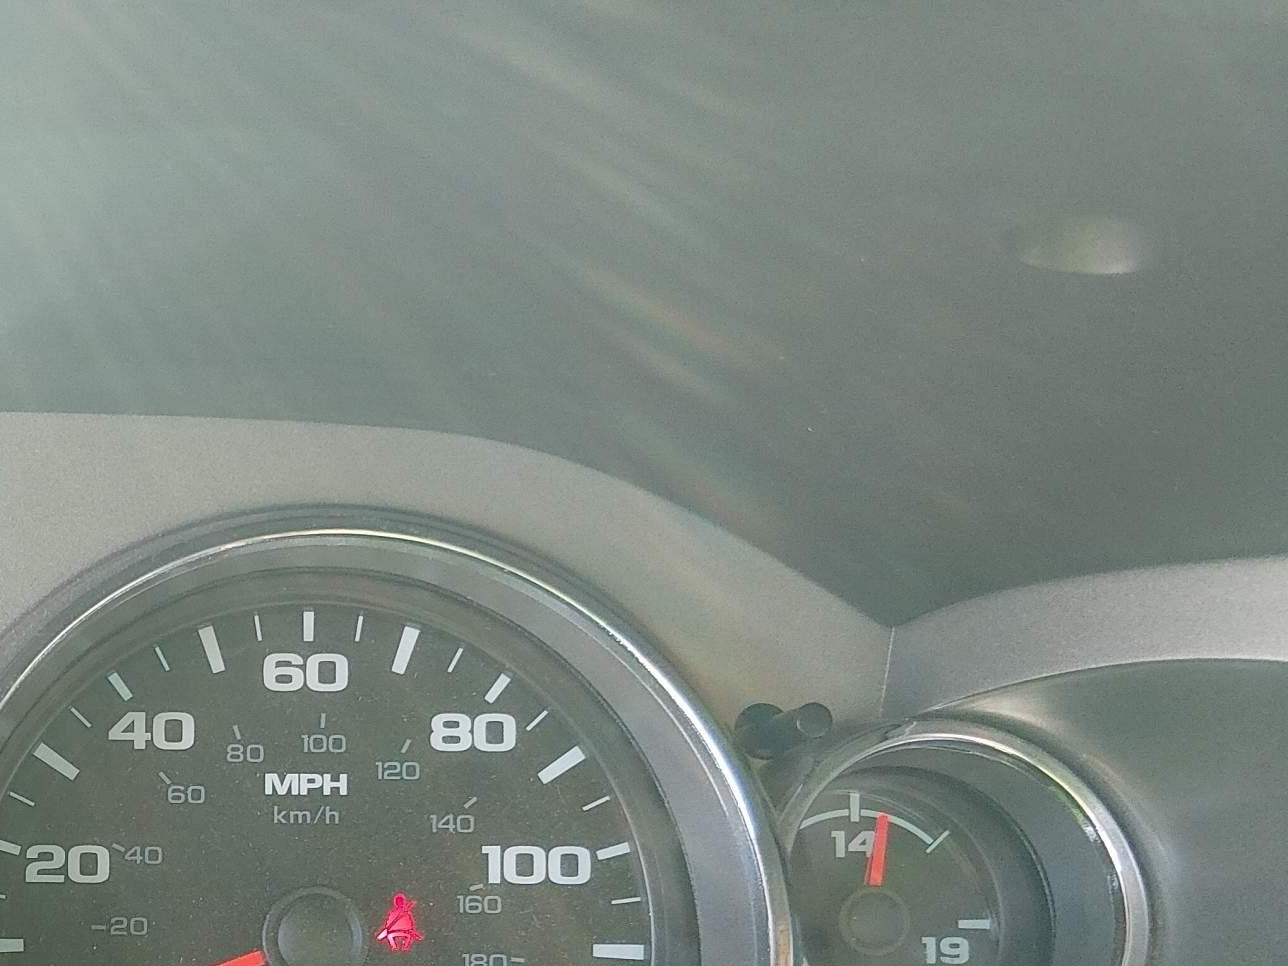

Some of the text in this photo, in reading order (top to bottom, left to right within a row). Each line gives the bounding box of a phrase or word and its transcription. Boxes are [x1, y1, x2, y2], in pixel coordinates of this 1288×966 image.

[262, 653, 349, 692] 60
[108, 711, 195, 750] 40
[430, 713, 517, 752] 80
[226, 743, 264, 763] 80
[301, 734, 347, 754] 100
[376, 761, 420, 781] 120
[167, 784, 205, 804] 60
[264, 773, 348, 796] MPH
[272, 806, 340, 825] km/h
[430, 814, 475, 833] 140
[831, 831, 874, 857] 14
[25, 844, 110, 883] 20
[124, 845, 163, 865] 40
[481, 845, 591, 884] 100
[457, 895, 502, 915] 160
[110, 916, 149, 936] 20
[921, 937, 971, 965] 19
